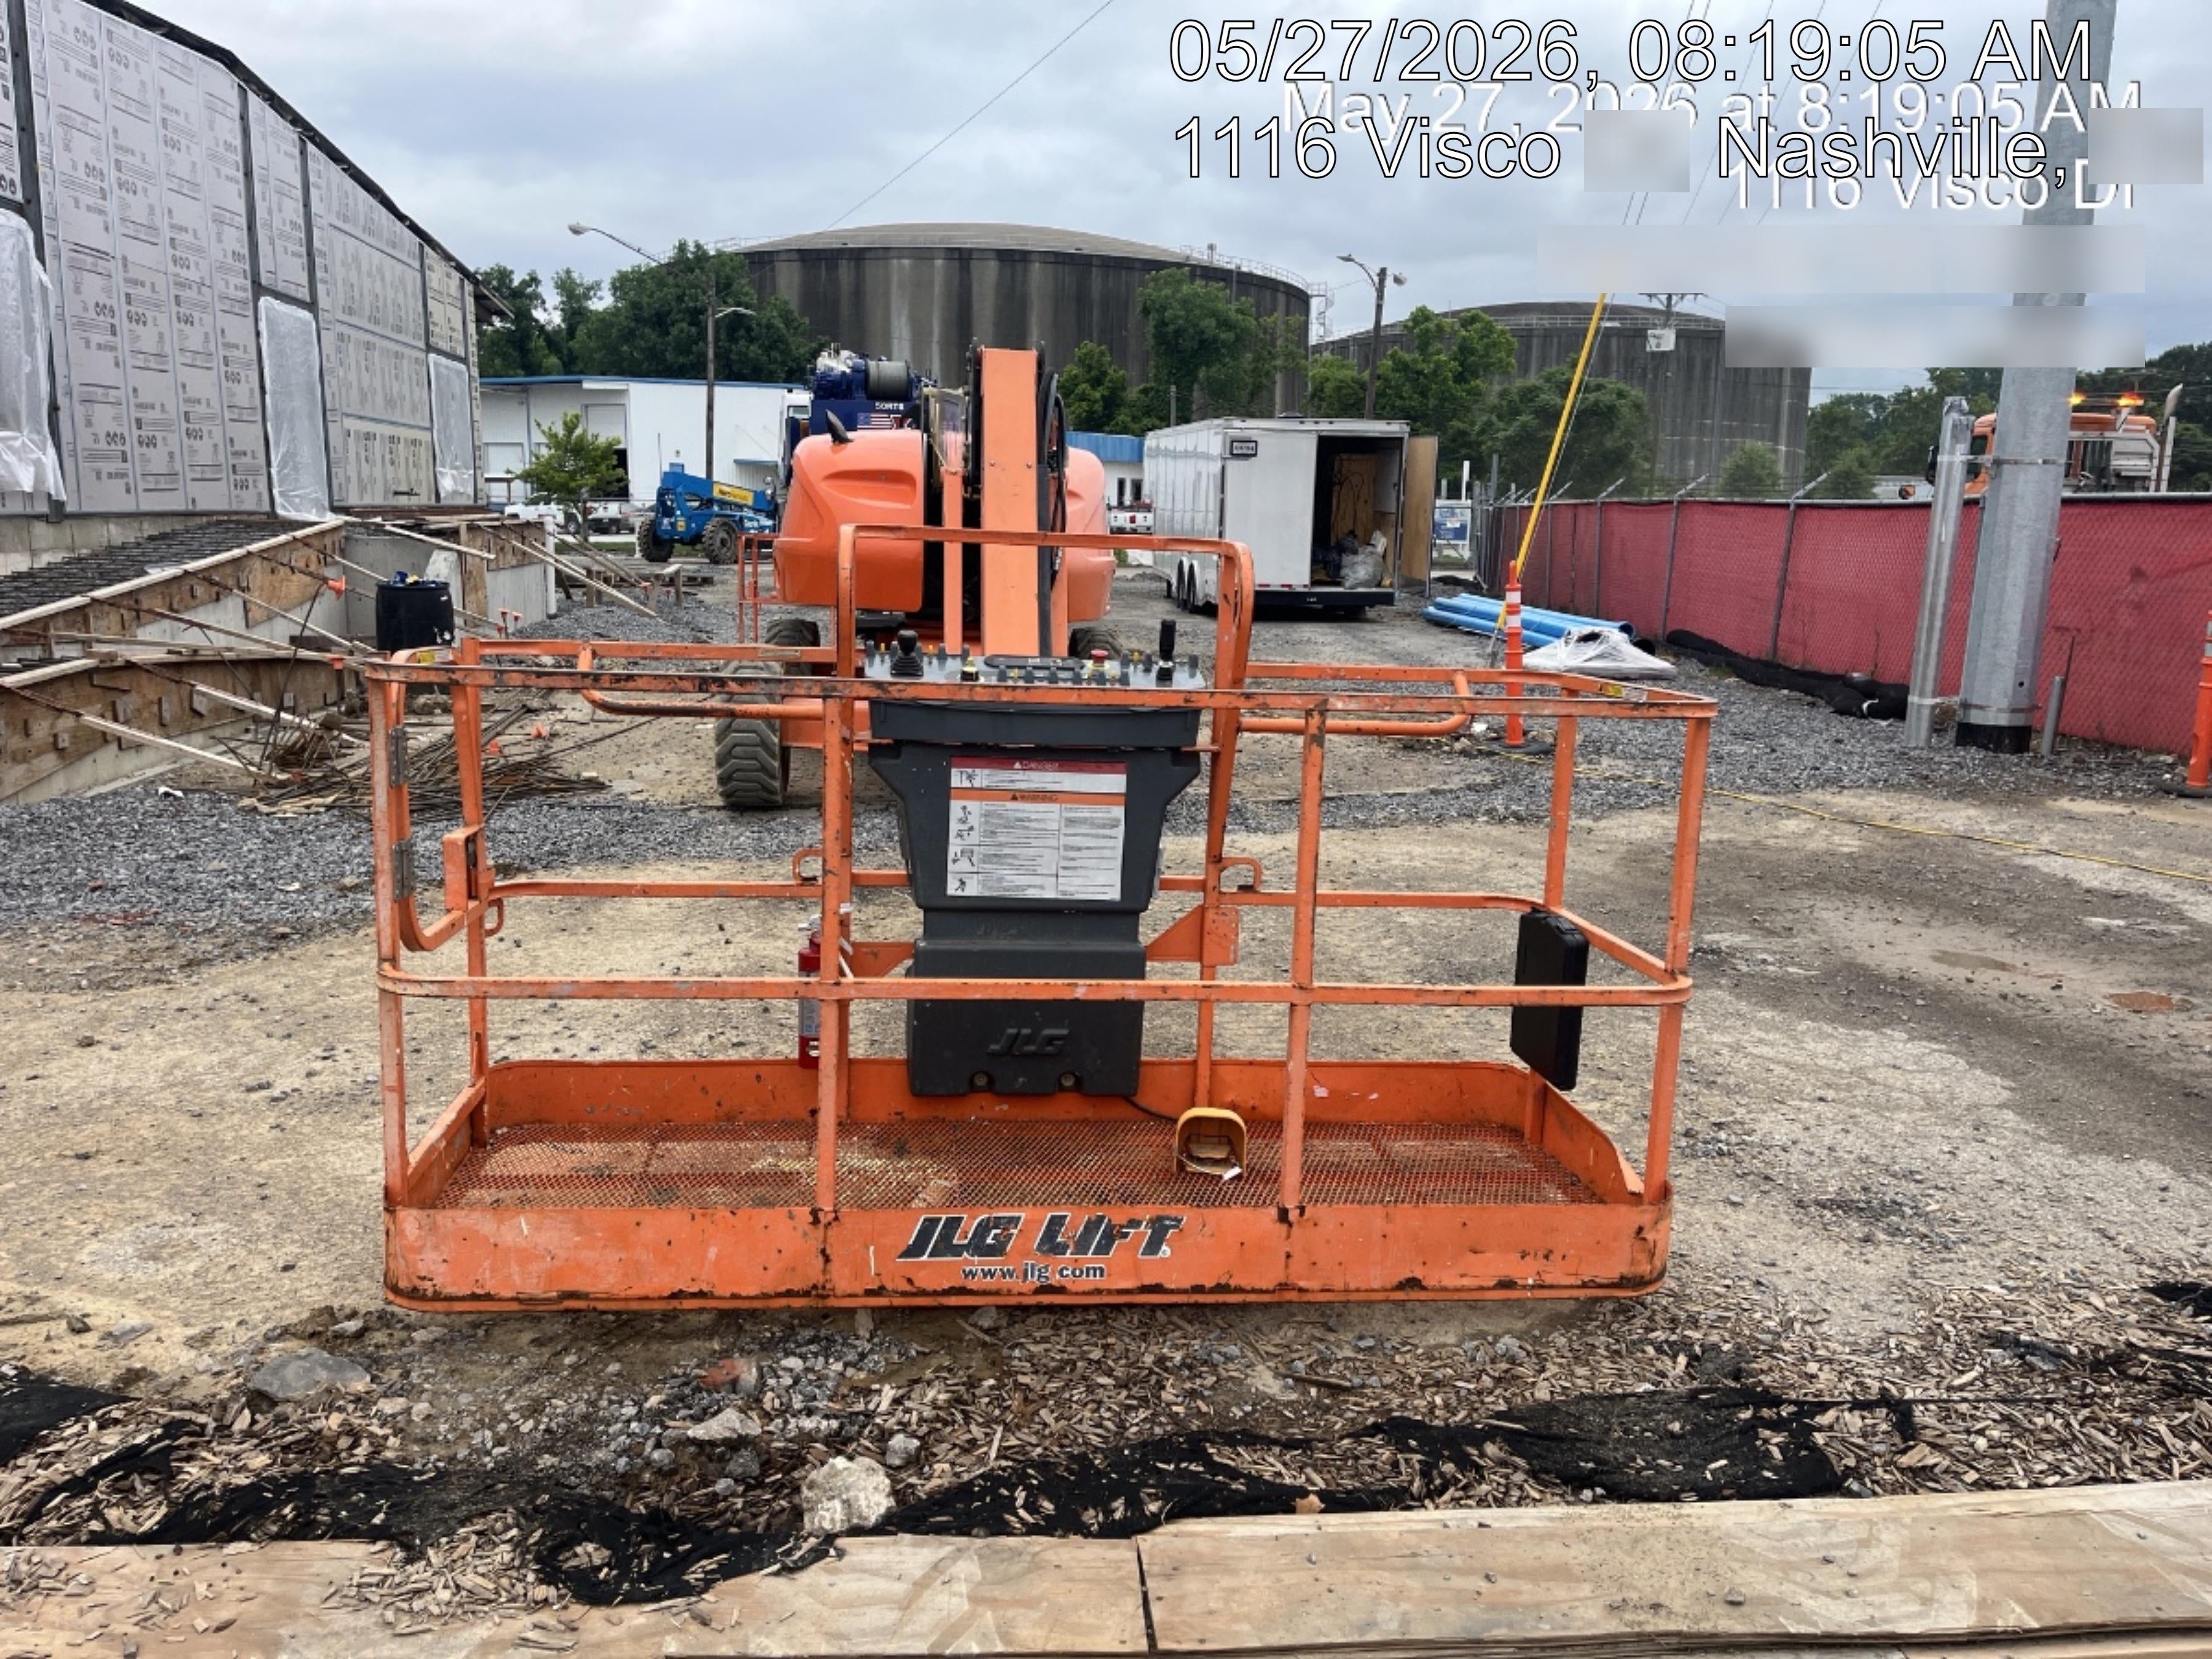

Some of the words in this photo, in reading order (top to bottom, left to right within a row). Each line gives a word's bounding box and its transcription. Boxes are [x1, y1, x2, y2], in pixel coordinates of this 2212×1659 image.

[896, 1212, 1026, 1261] JLG
[1033, 1212, 1186, 1259] LIFT
[961, 1261, 1105, 1284] www.jlgcom
